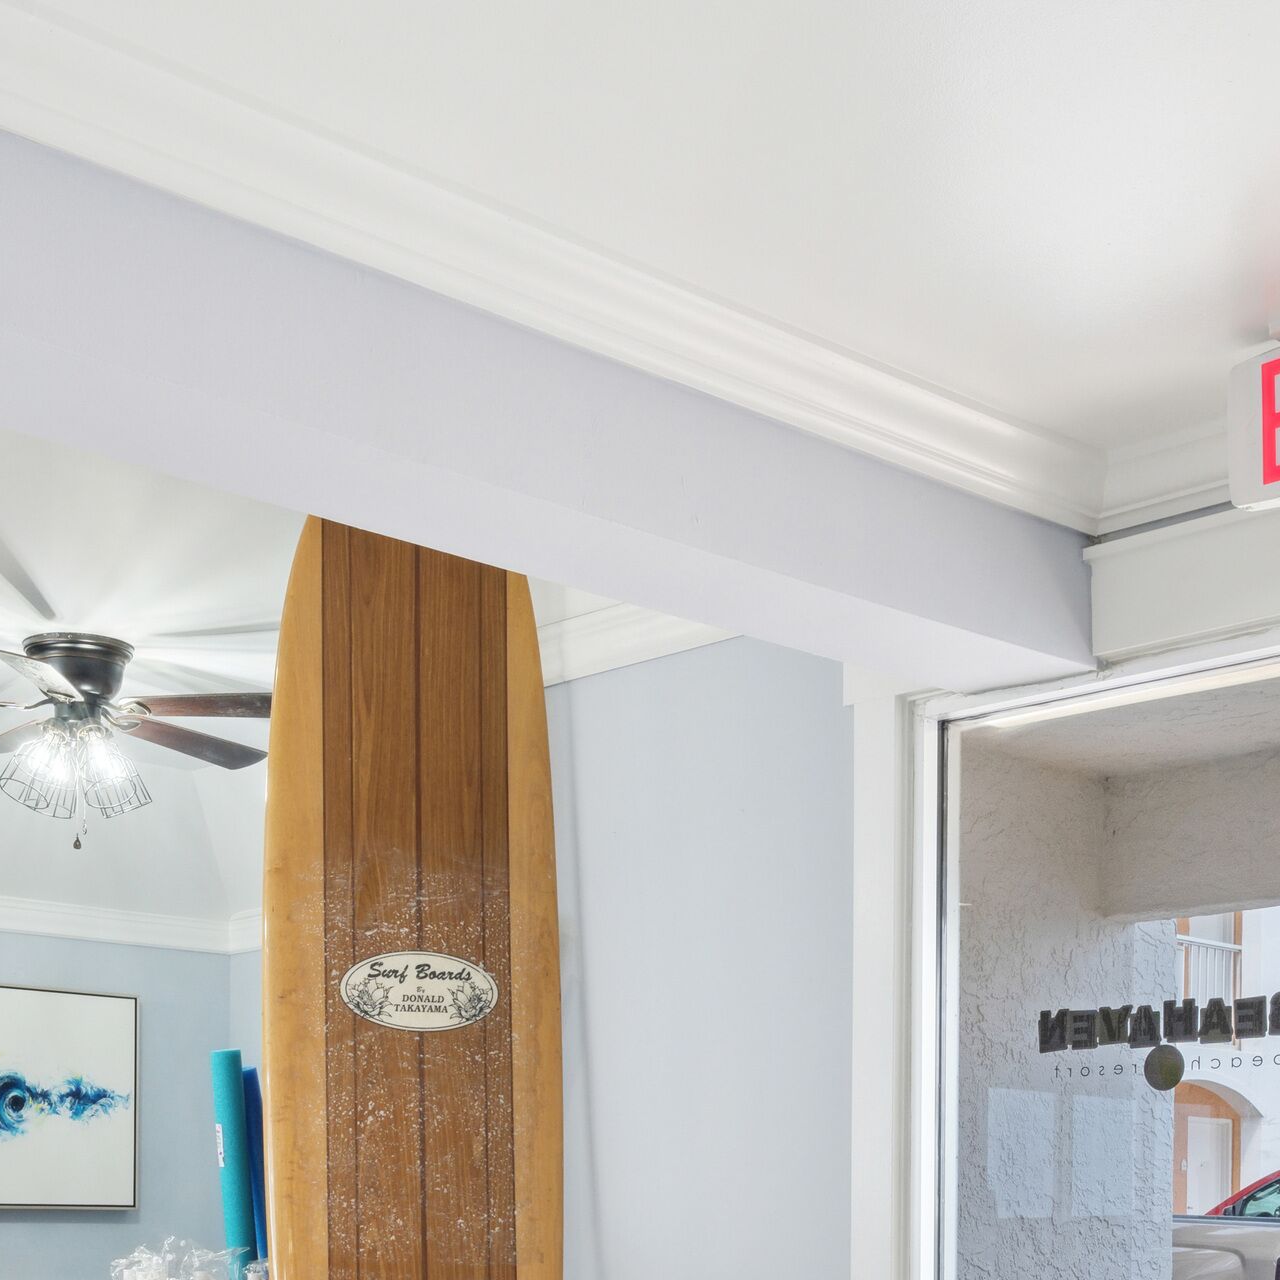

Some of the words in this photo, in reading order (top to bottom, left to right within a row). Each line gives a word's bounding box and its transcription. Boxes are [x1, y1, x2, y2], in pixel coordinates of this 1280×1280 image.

[367, 961, 409, 984] Surf
[415, 963, 473, 981] Boards
[402, 994, 445, 1003] DONALD
[394, 1003, 449, 1013] TAKAYAMA
